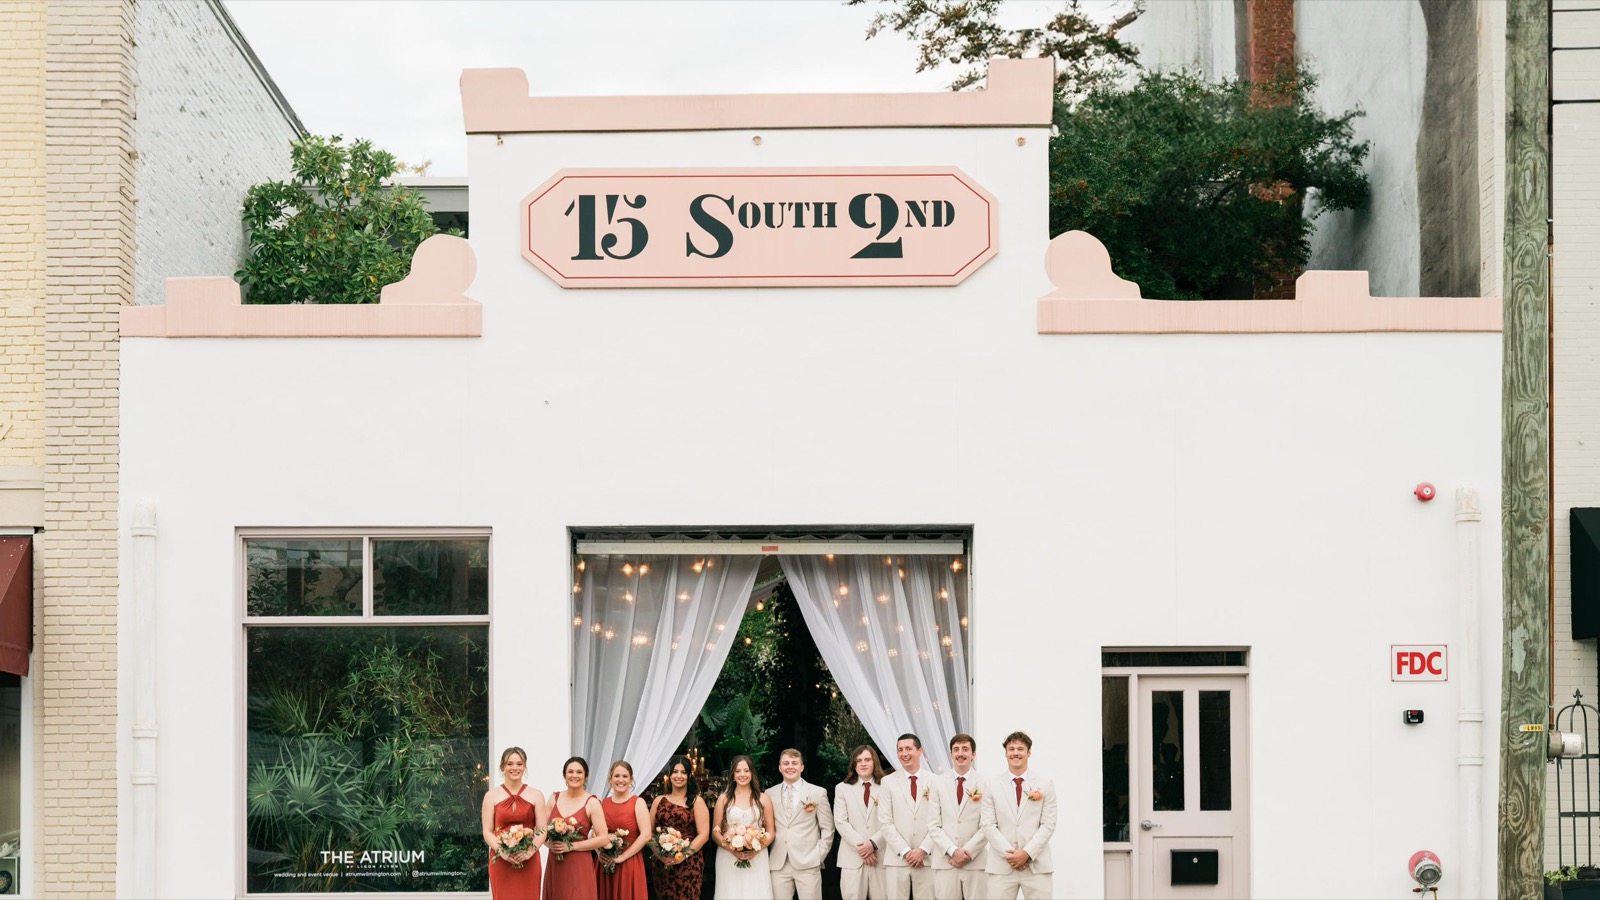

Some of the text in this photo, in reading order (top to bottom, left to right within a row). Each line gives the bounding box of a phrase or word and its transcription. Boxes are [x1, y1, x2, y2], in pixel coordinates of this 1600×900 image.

[564, 194, 649, 261] 15
[848, 193, 955, 259] 2ND
[1396, 651, 1442, 675] FDC
[320, 850, 425, 864] THE ATRIUM
